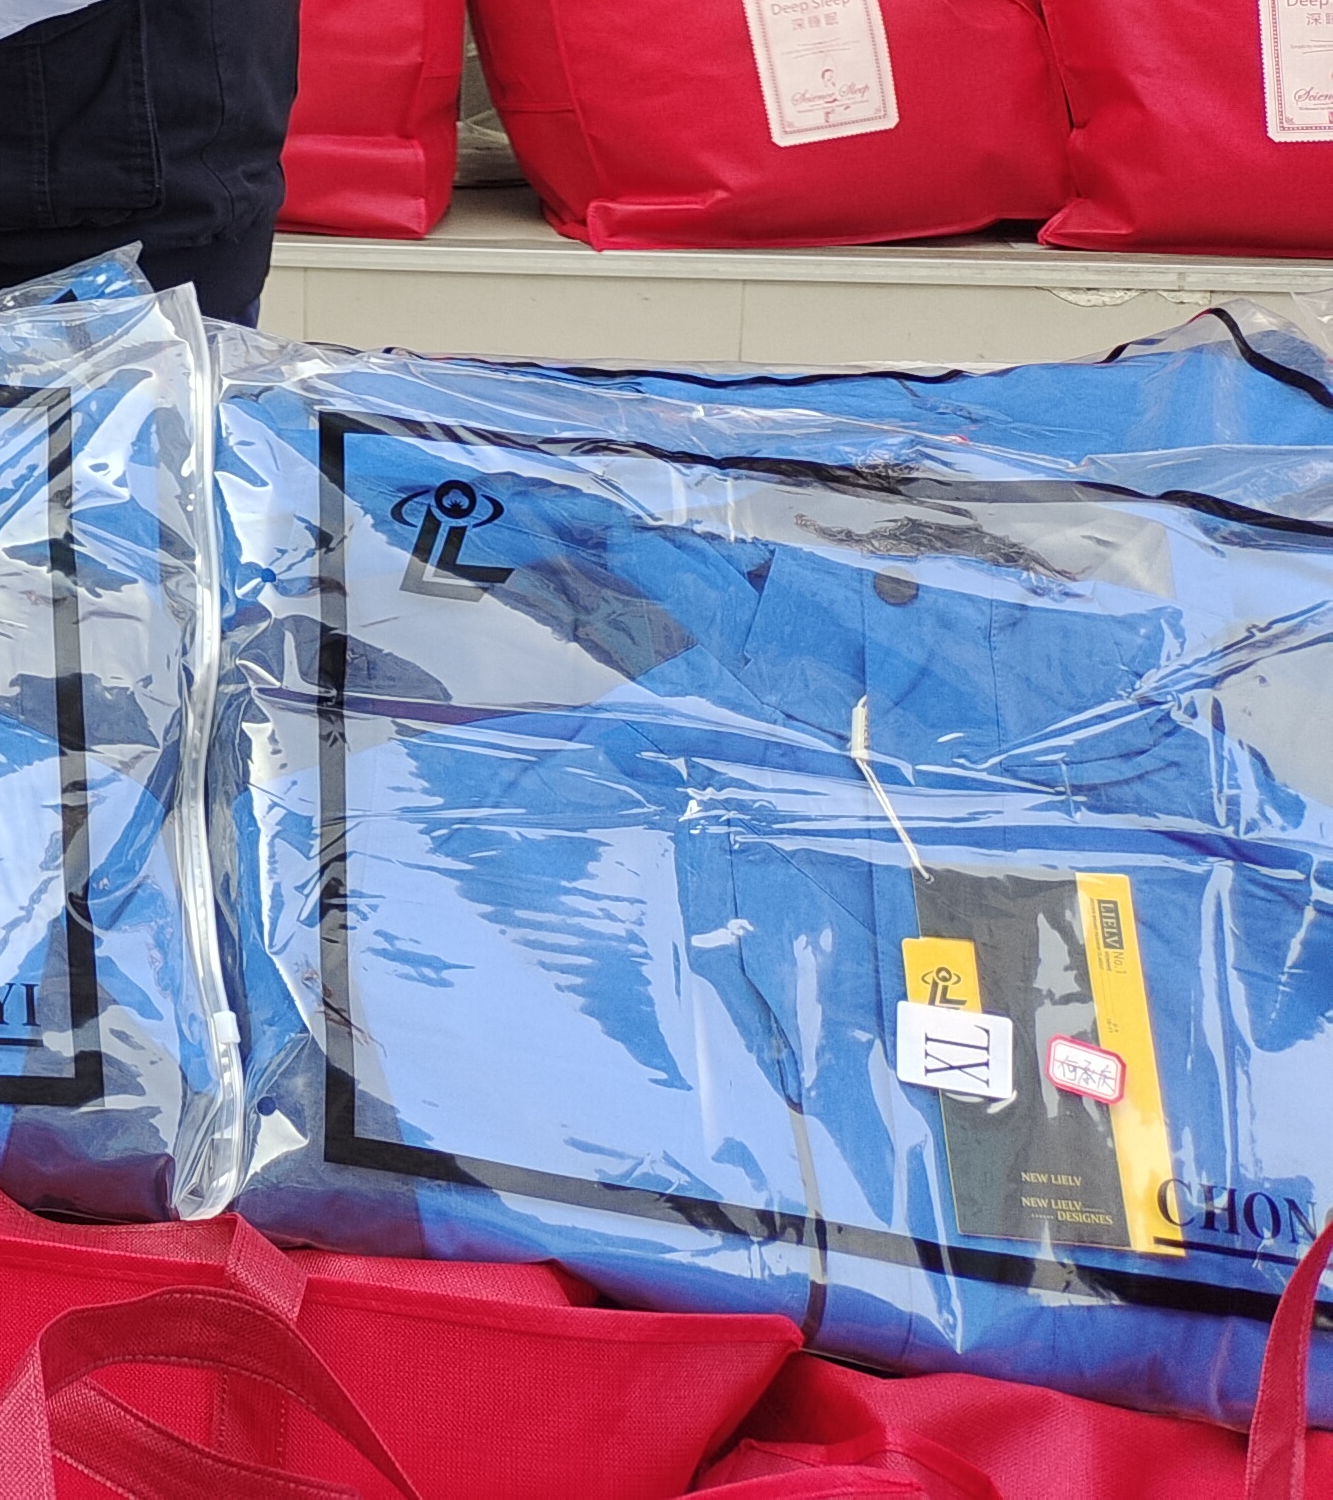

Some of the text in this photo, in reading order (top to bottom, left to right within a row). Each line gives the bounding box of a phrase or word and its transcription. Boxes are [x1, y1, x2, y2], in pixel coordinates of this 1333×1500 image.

[771, 0, 809, 15] Deep
[791, 12, 839, 31] 深睡眠
[1100, 902, 1120, 948] LIELV
[1113, 951, 1127, 975] No.1
[924, 1024, 992, 1088] XL
[1021, 1171, 1082, 1187] NEW LIELV
[1021, 1196, 1049, 1208] NEW
[1051, 1199, 1082, 1211] LIELV
[1157, 1178, 1333, 1244] CHON
[1057, 1210, 1113, 1225] DESIGNES
